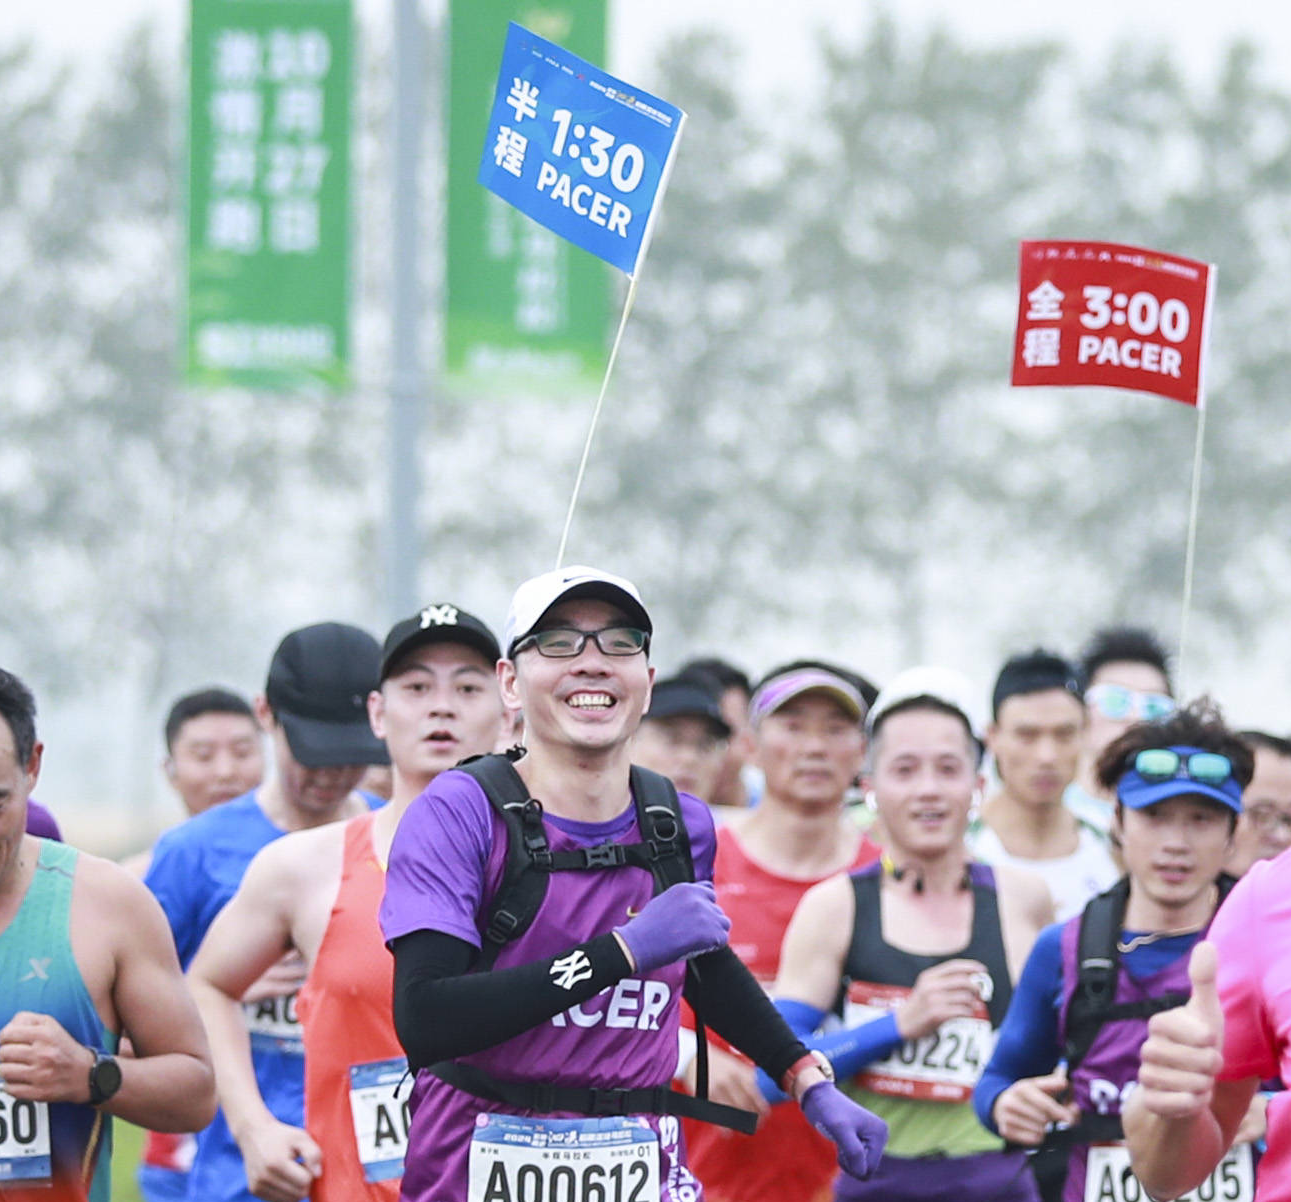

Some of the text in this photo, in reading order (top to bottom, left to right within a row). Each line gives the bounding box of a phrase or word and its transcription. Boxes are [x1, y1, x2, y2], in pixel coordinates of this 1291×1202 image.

[493, 77, 540, 178] 半程
[551, 108, 645, 193] 1:30
[536, 161, 632, 238] PACER
[1022, 280, 1065, 368] 全程
[1079, 285, 1190, 343] 3:00
[1078, 335, 1182, 379] PACER
[551, 978, 670, 1031] CER
[637, 1145, 651, 1158] 01
